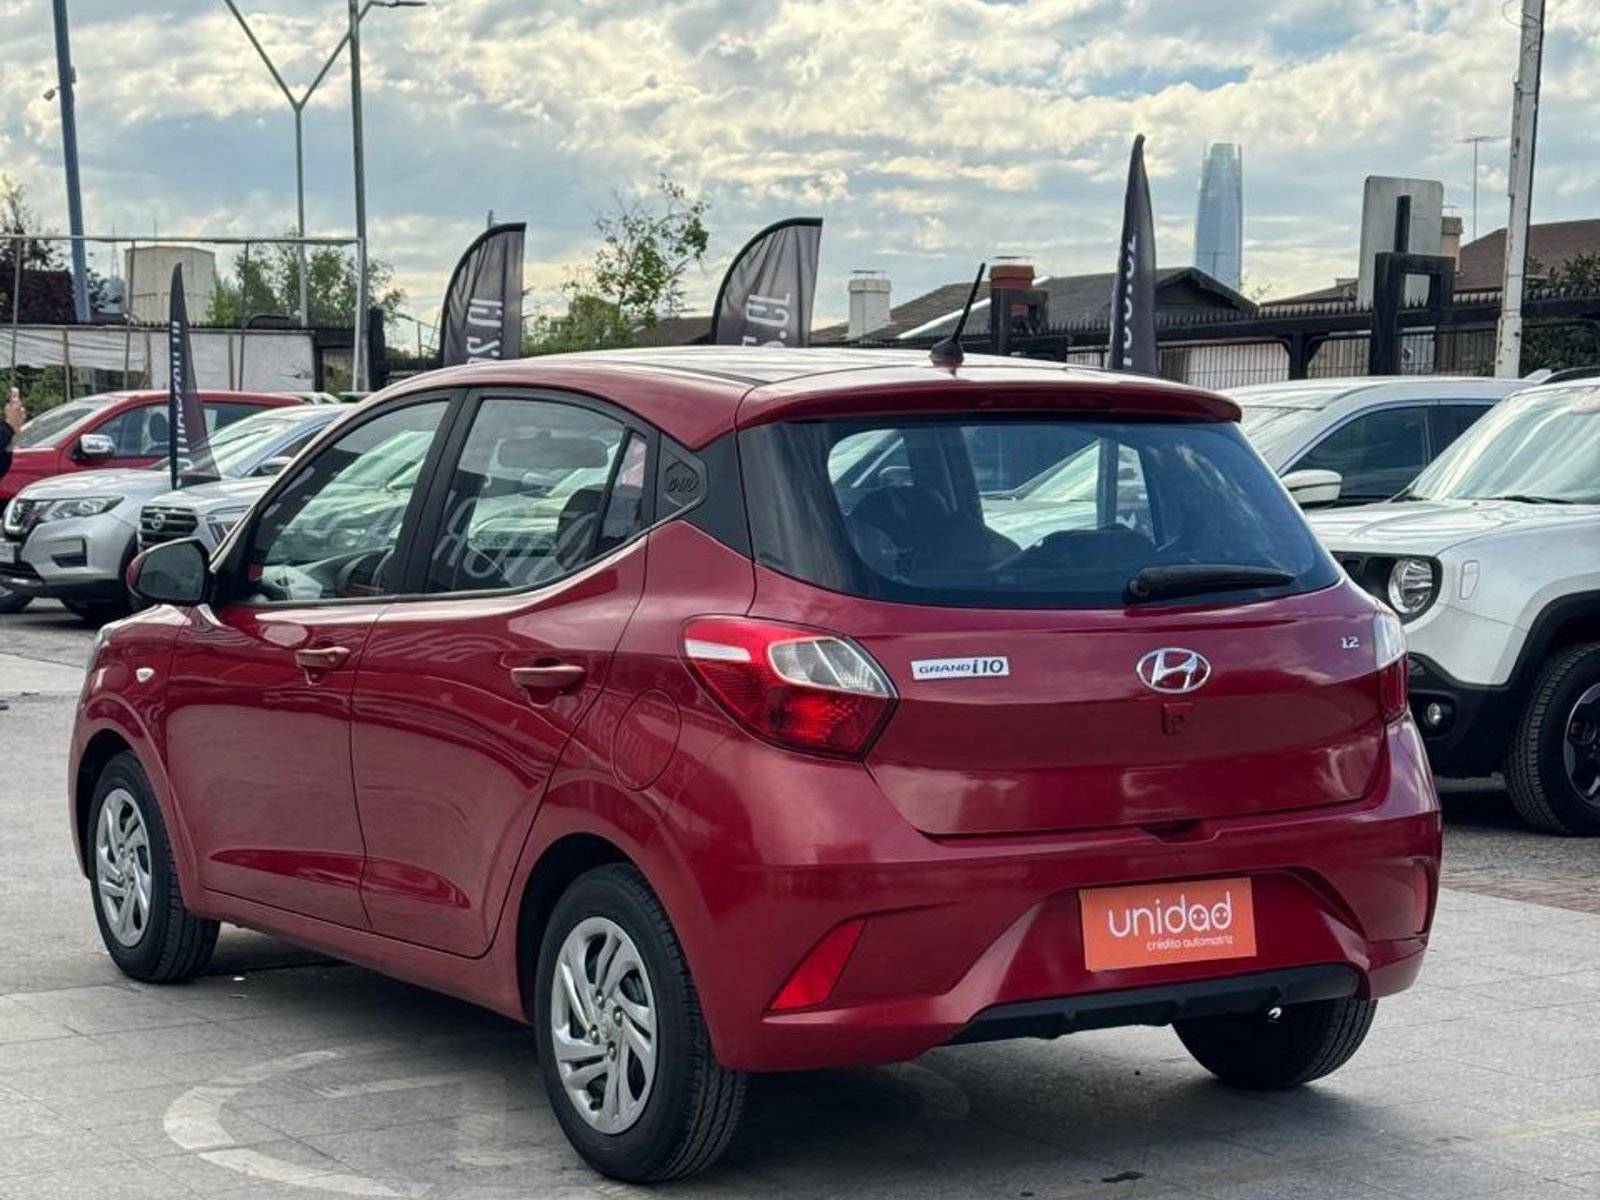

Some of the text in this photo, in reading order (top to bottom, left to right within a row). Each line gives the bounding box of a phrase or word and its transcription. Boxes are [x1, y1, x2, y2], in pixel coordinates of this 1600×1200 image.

[919, 663, 971, 674] GRAND
[1107, 890, 1233, 938] unidad
[1182, 934, 1234, 948] automotriz
